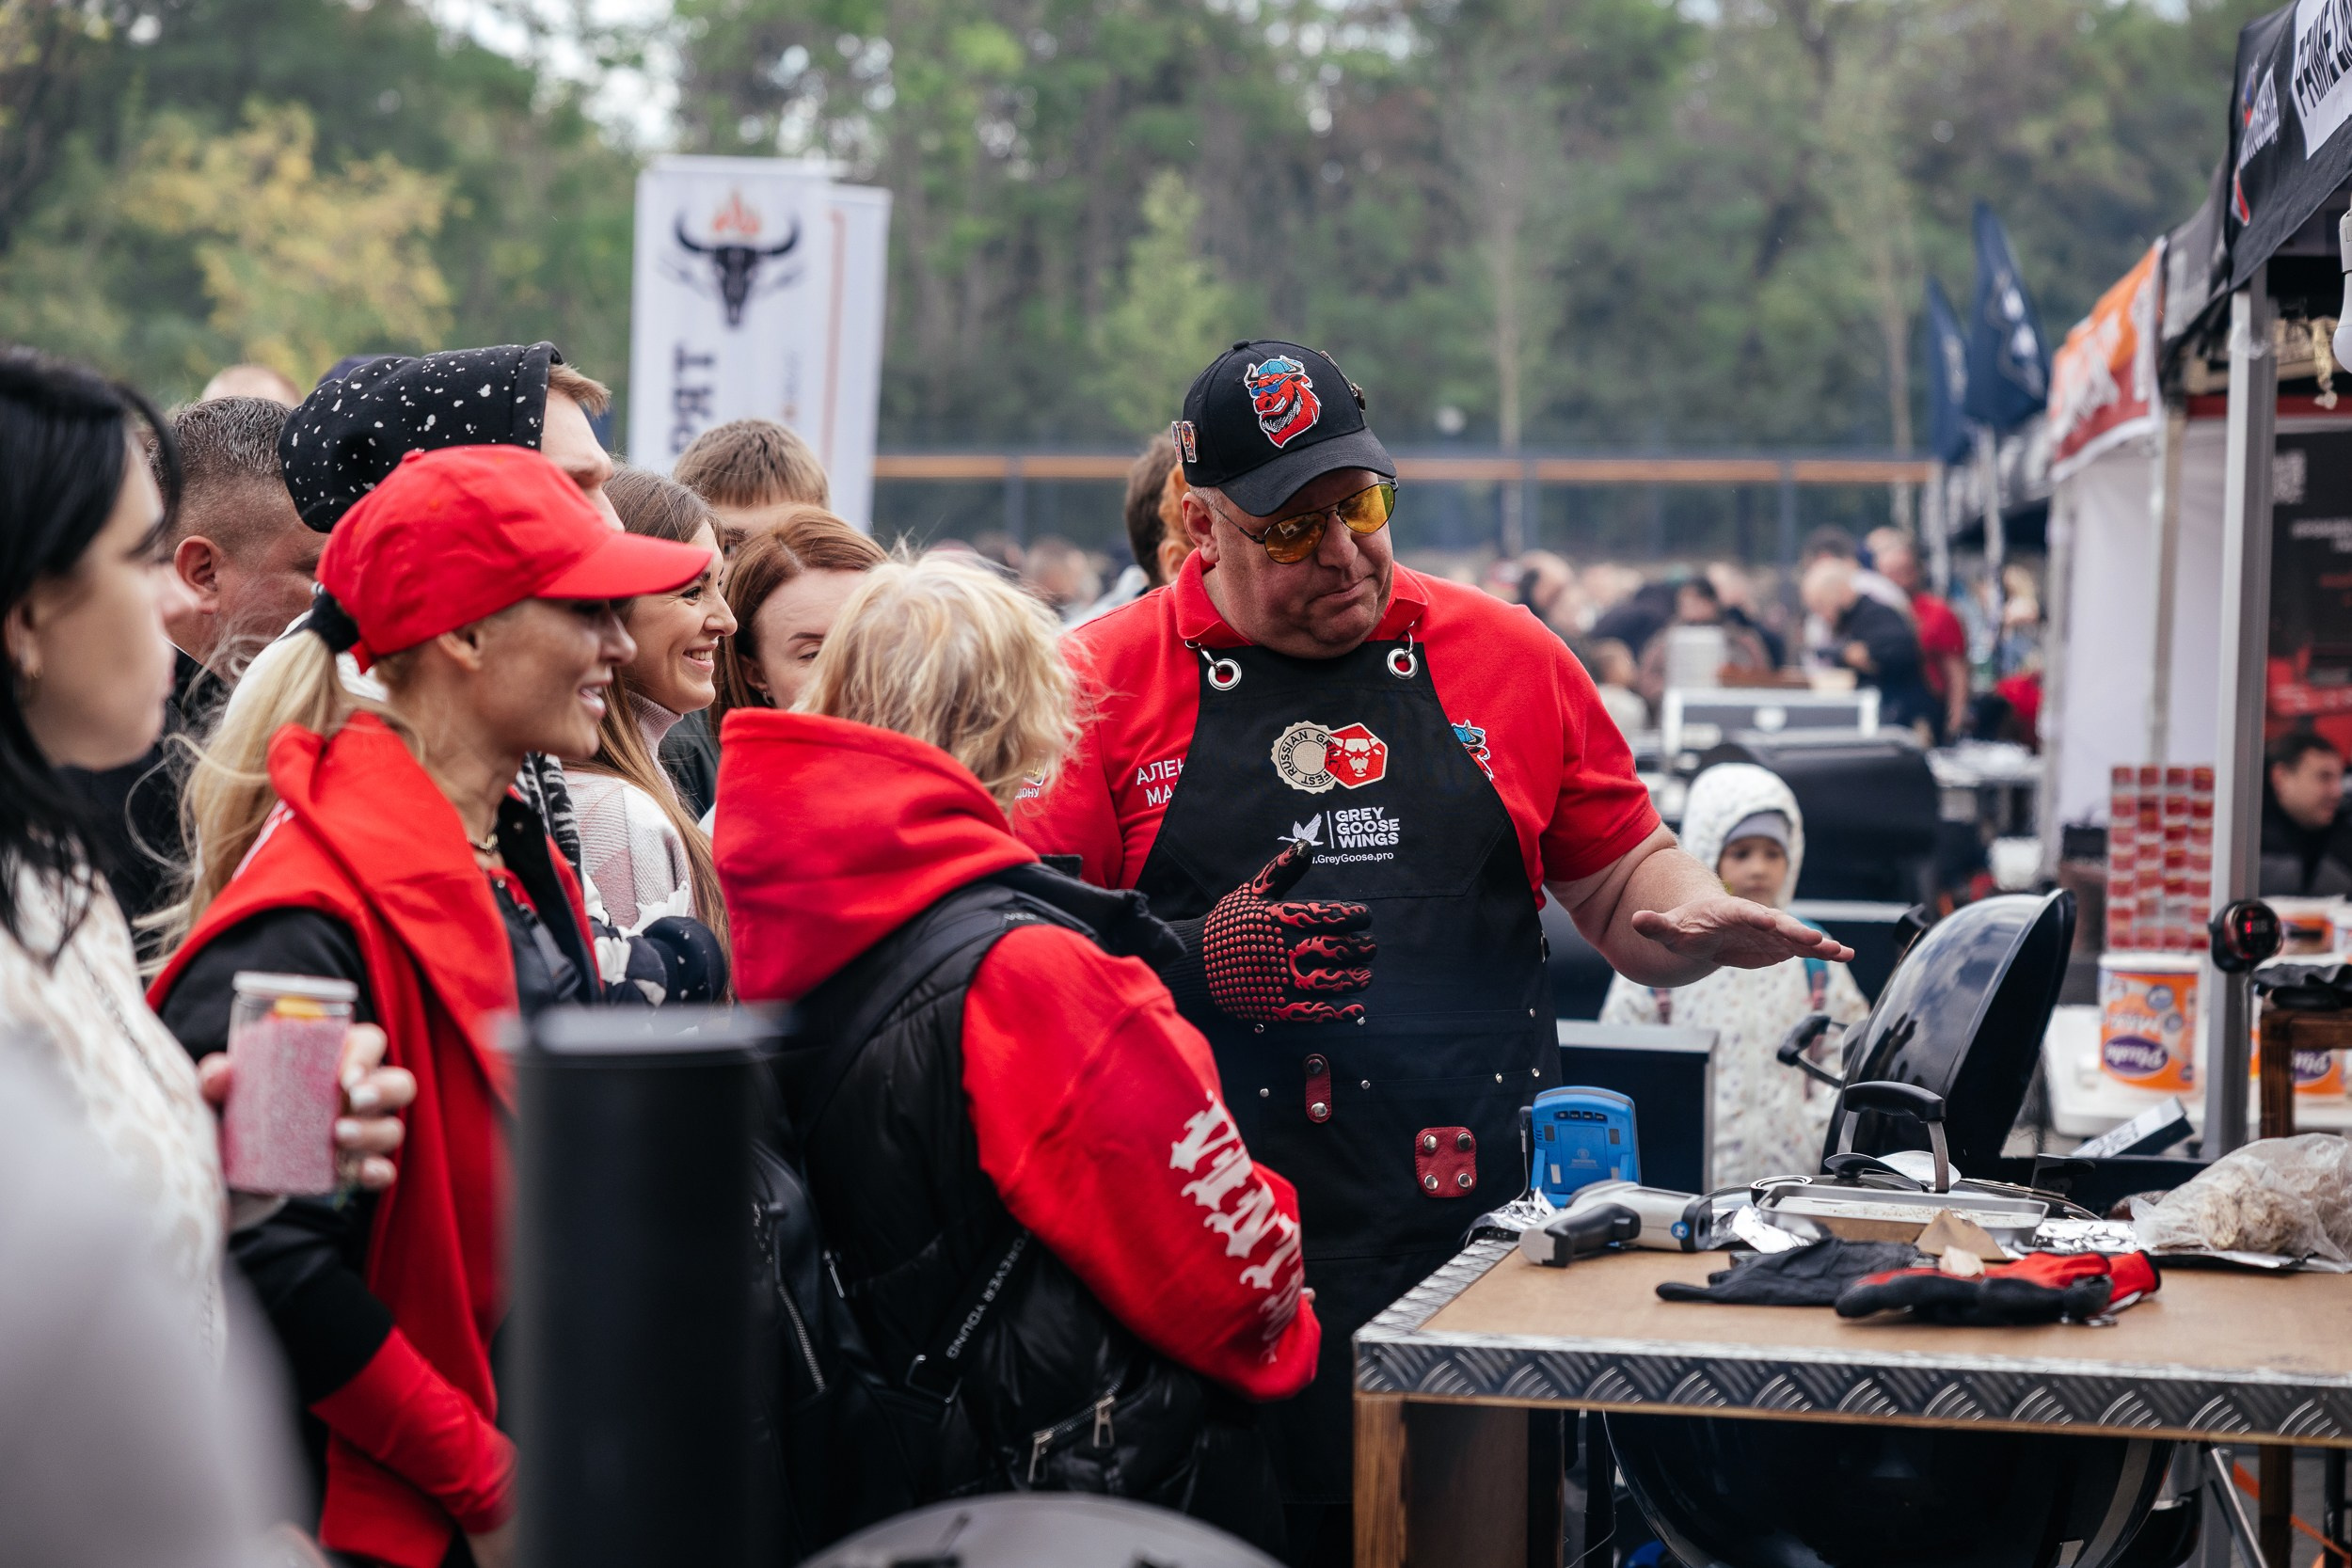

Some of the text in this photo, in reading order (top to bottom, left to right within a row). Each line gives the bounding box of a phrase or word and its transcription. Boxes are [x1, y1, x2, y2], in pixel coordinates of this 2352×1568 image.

[1280, 730, 1309, 777] RUSSIAN
[1300, 770, 1332, 786] FEST
[1335, 806, 1385, 823] GREY
[1336, 817, 1401, 835] GOOSE
[1338, 832, 1400, 849] WINGS
[946, 1304, 988, 1360] YOUNG
